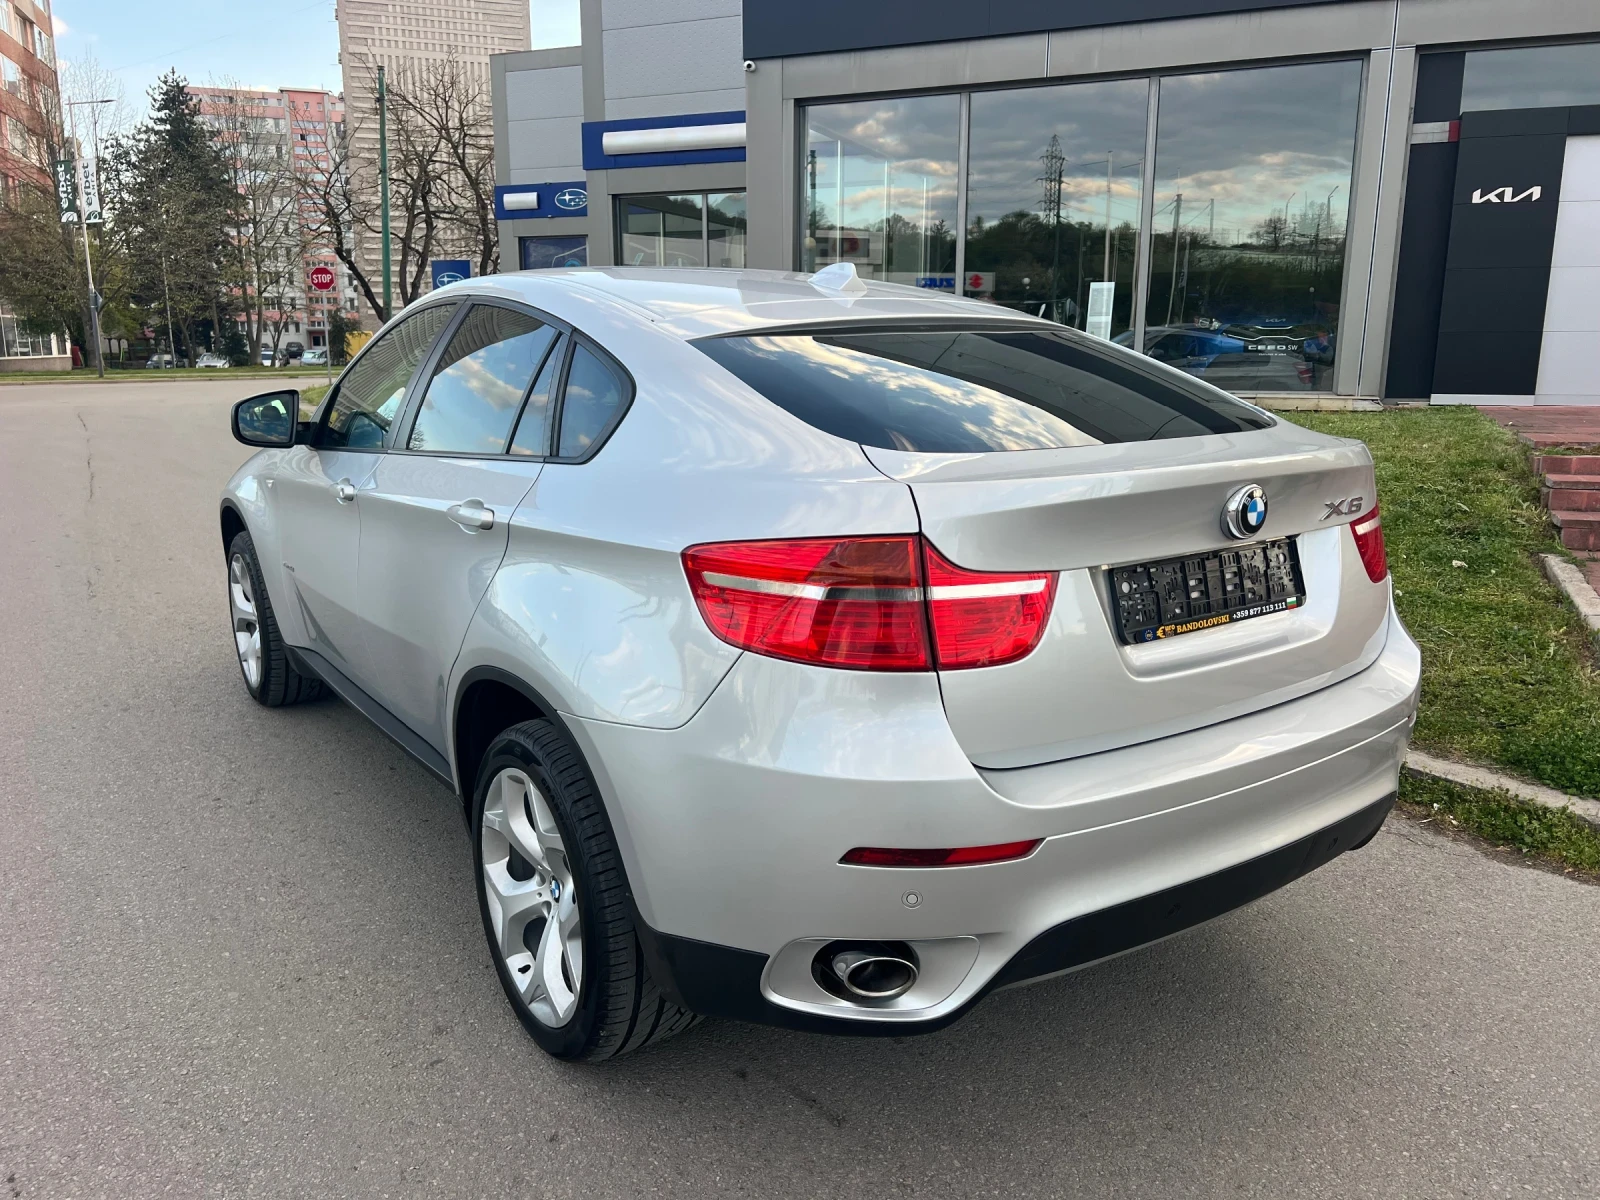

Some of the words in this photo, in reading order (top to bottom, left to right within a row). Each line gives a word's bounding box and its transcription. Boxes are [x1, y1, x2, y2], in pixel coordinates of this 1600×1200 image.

[56, 163, 69, 210] efbet
[82, 162, 93, 206] efbet
[1471, 185, 1542, 204] KIA
[312, 274, 332, 284] STOP
[1319, 496, 1364, 522] X6
[1232, 611, 1249, 620] +359
[1249, 607, 1261, 616] 877
[1262, 604, 1274, 613] 113
[1274, 601, 1286, 610] 111
